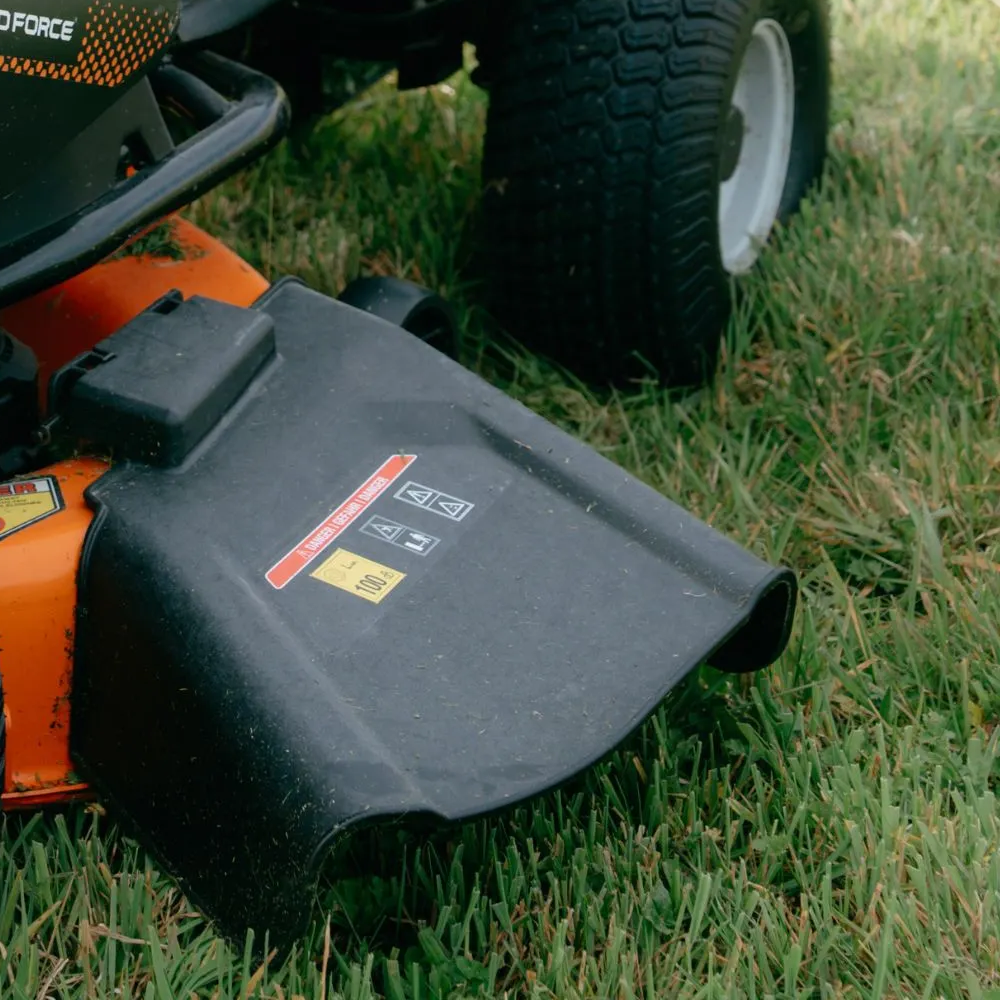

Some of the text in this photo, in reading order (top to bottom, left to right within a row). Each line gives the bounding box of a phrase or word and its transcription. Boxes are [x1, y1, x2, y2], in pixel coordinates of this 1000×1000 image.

[306, 527, 335, 552] DANGER
[360, 476, 389, 501] DANGER
[354, 574, 387, 596] 100
